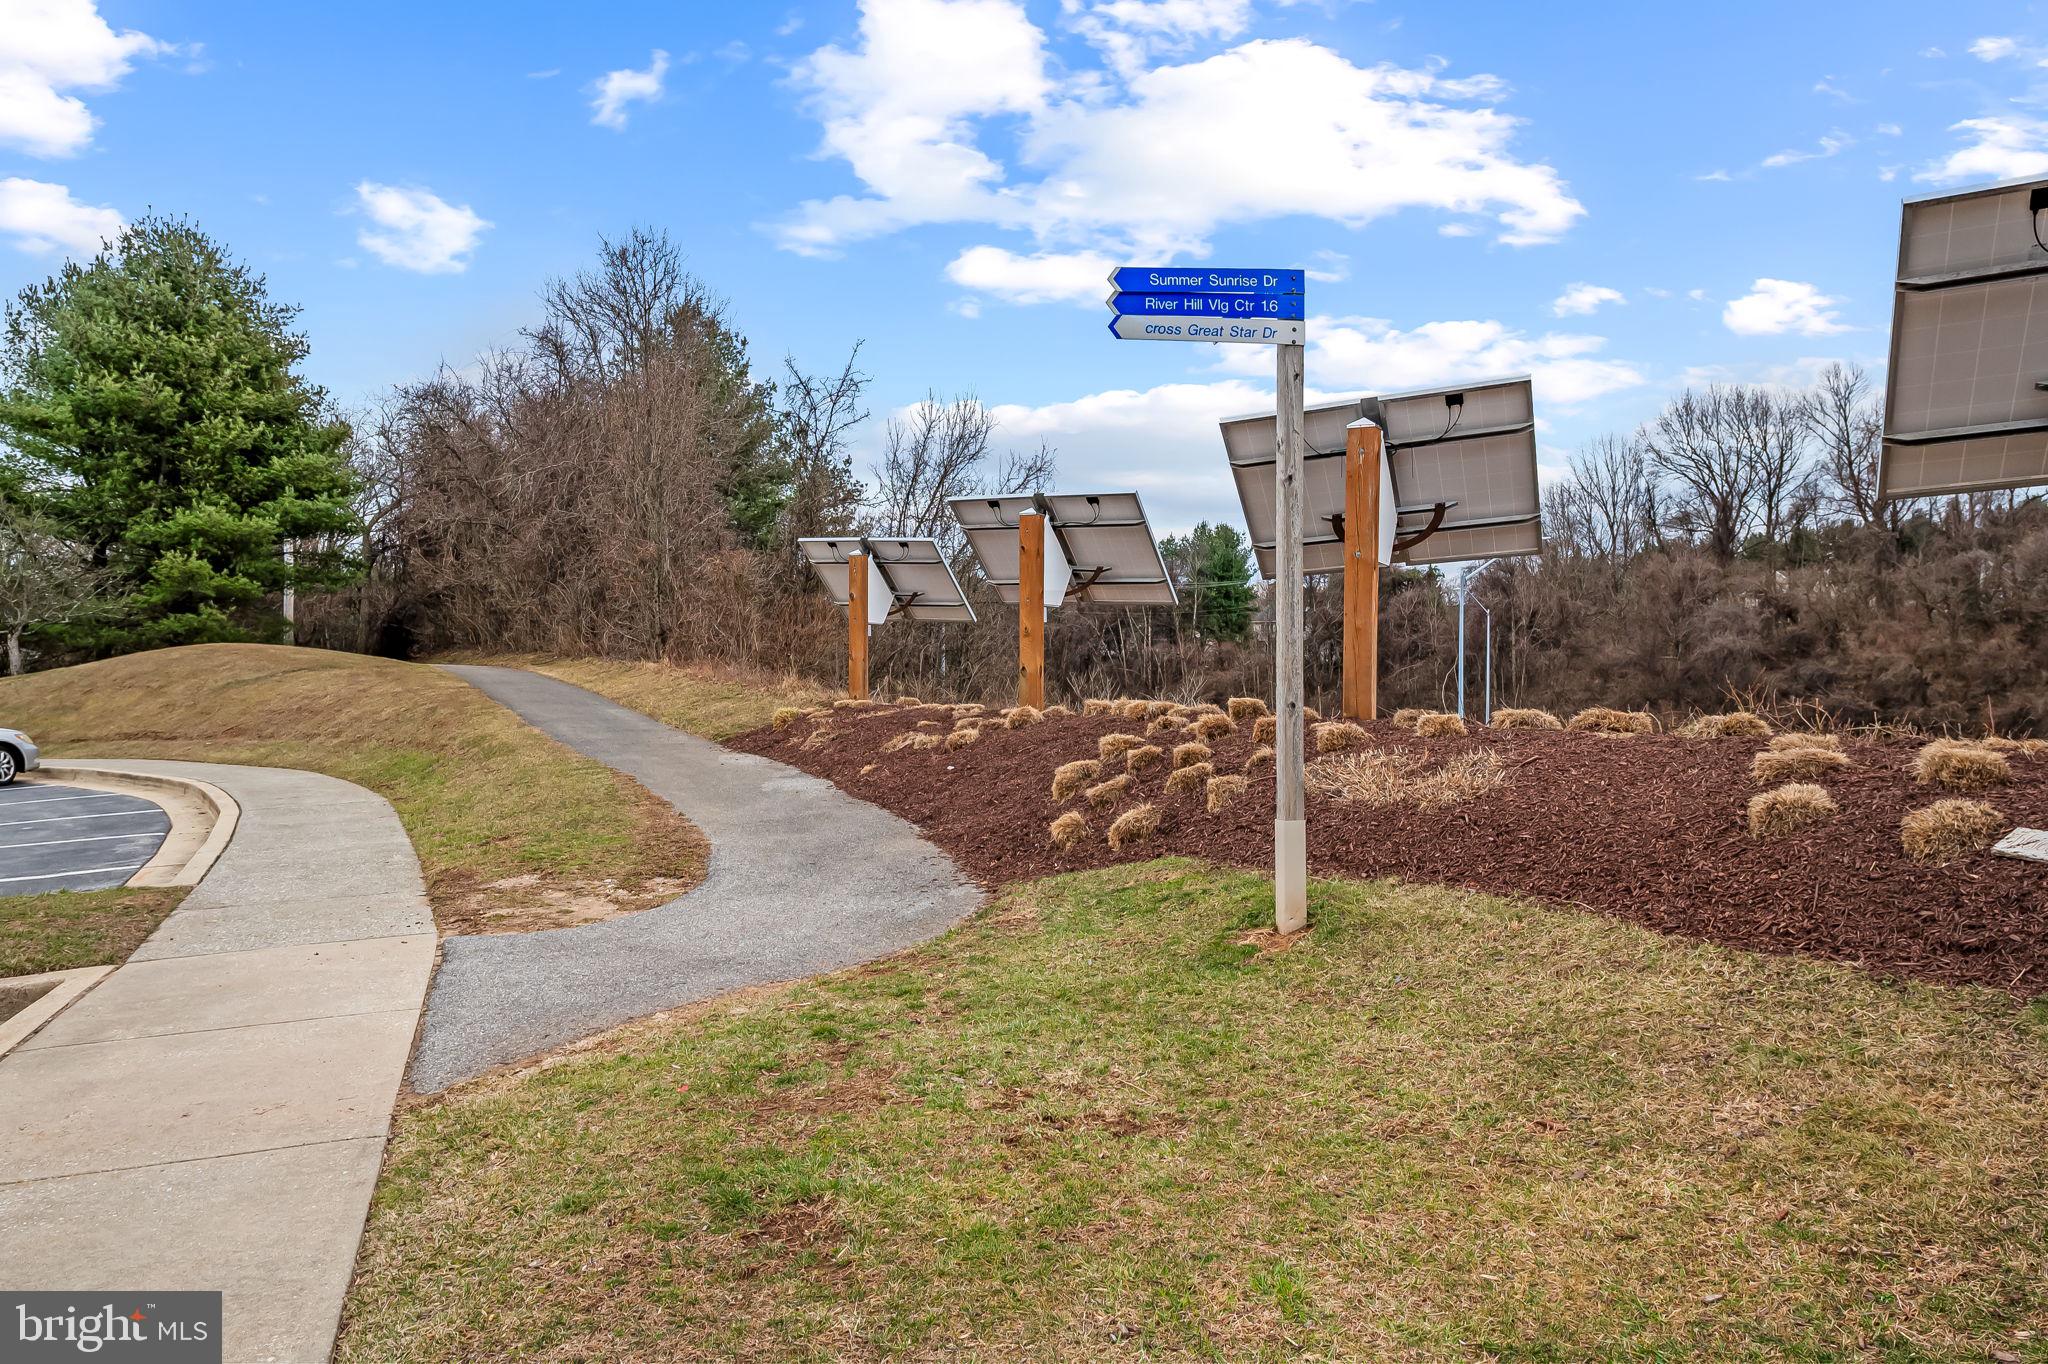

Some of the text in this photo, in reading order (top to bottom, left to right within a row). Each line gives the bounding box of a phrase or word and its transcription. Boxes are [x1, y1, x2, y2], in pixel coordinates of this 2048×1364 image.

[1149, 273, 1279, 287] Summer Sunrise Dr
[1145, 298, 1278, 313] River Hill Vlg Ctr 1.6
[1145, 323, 1278, 339] cross Great Star Dr
